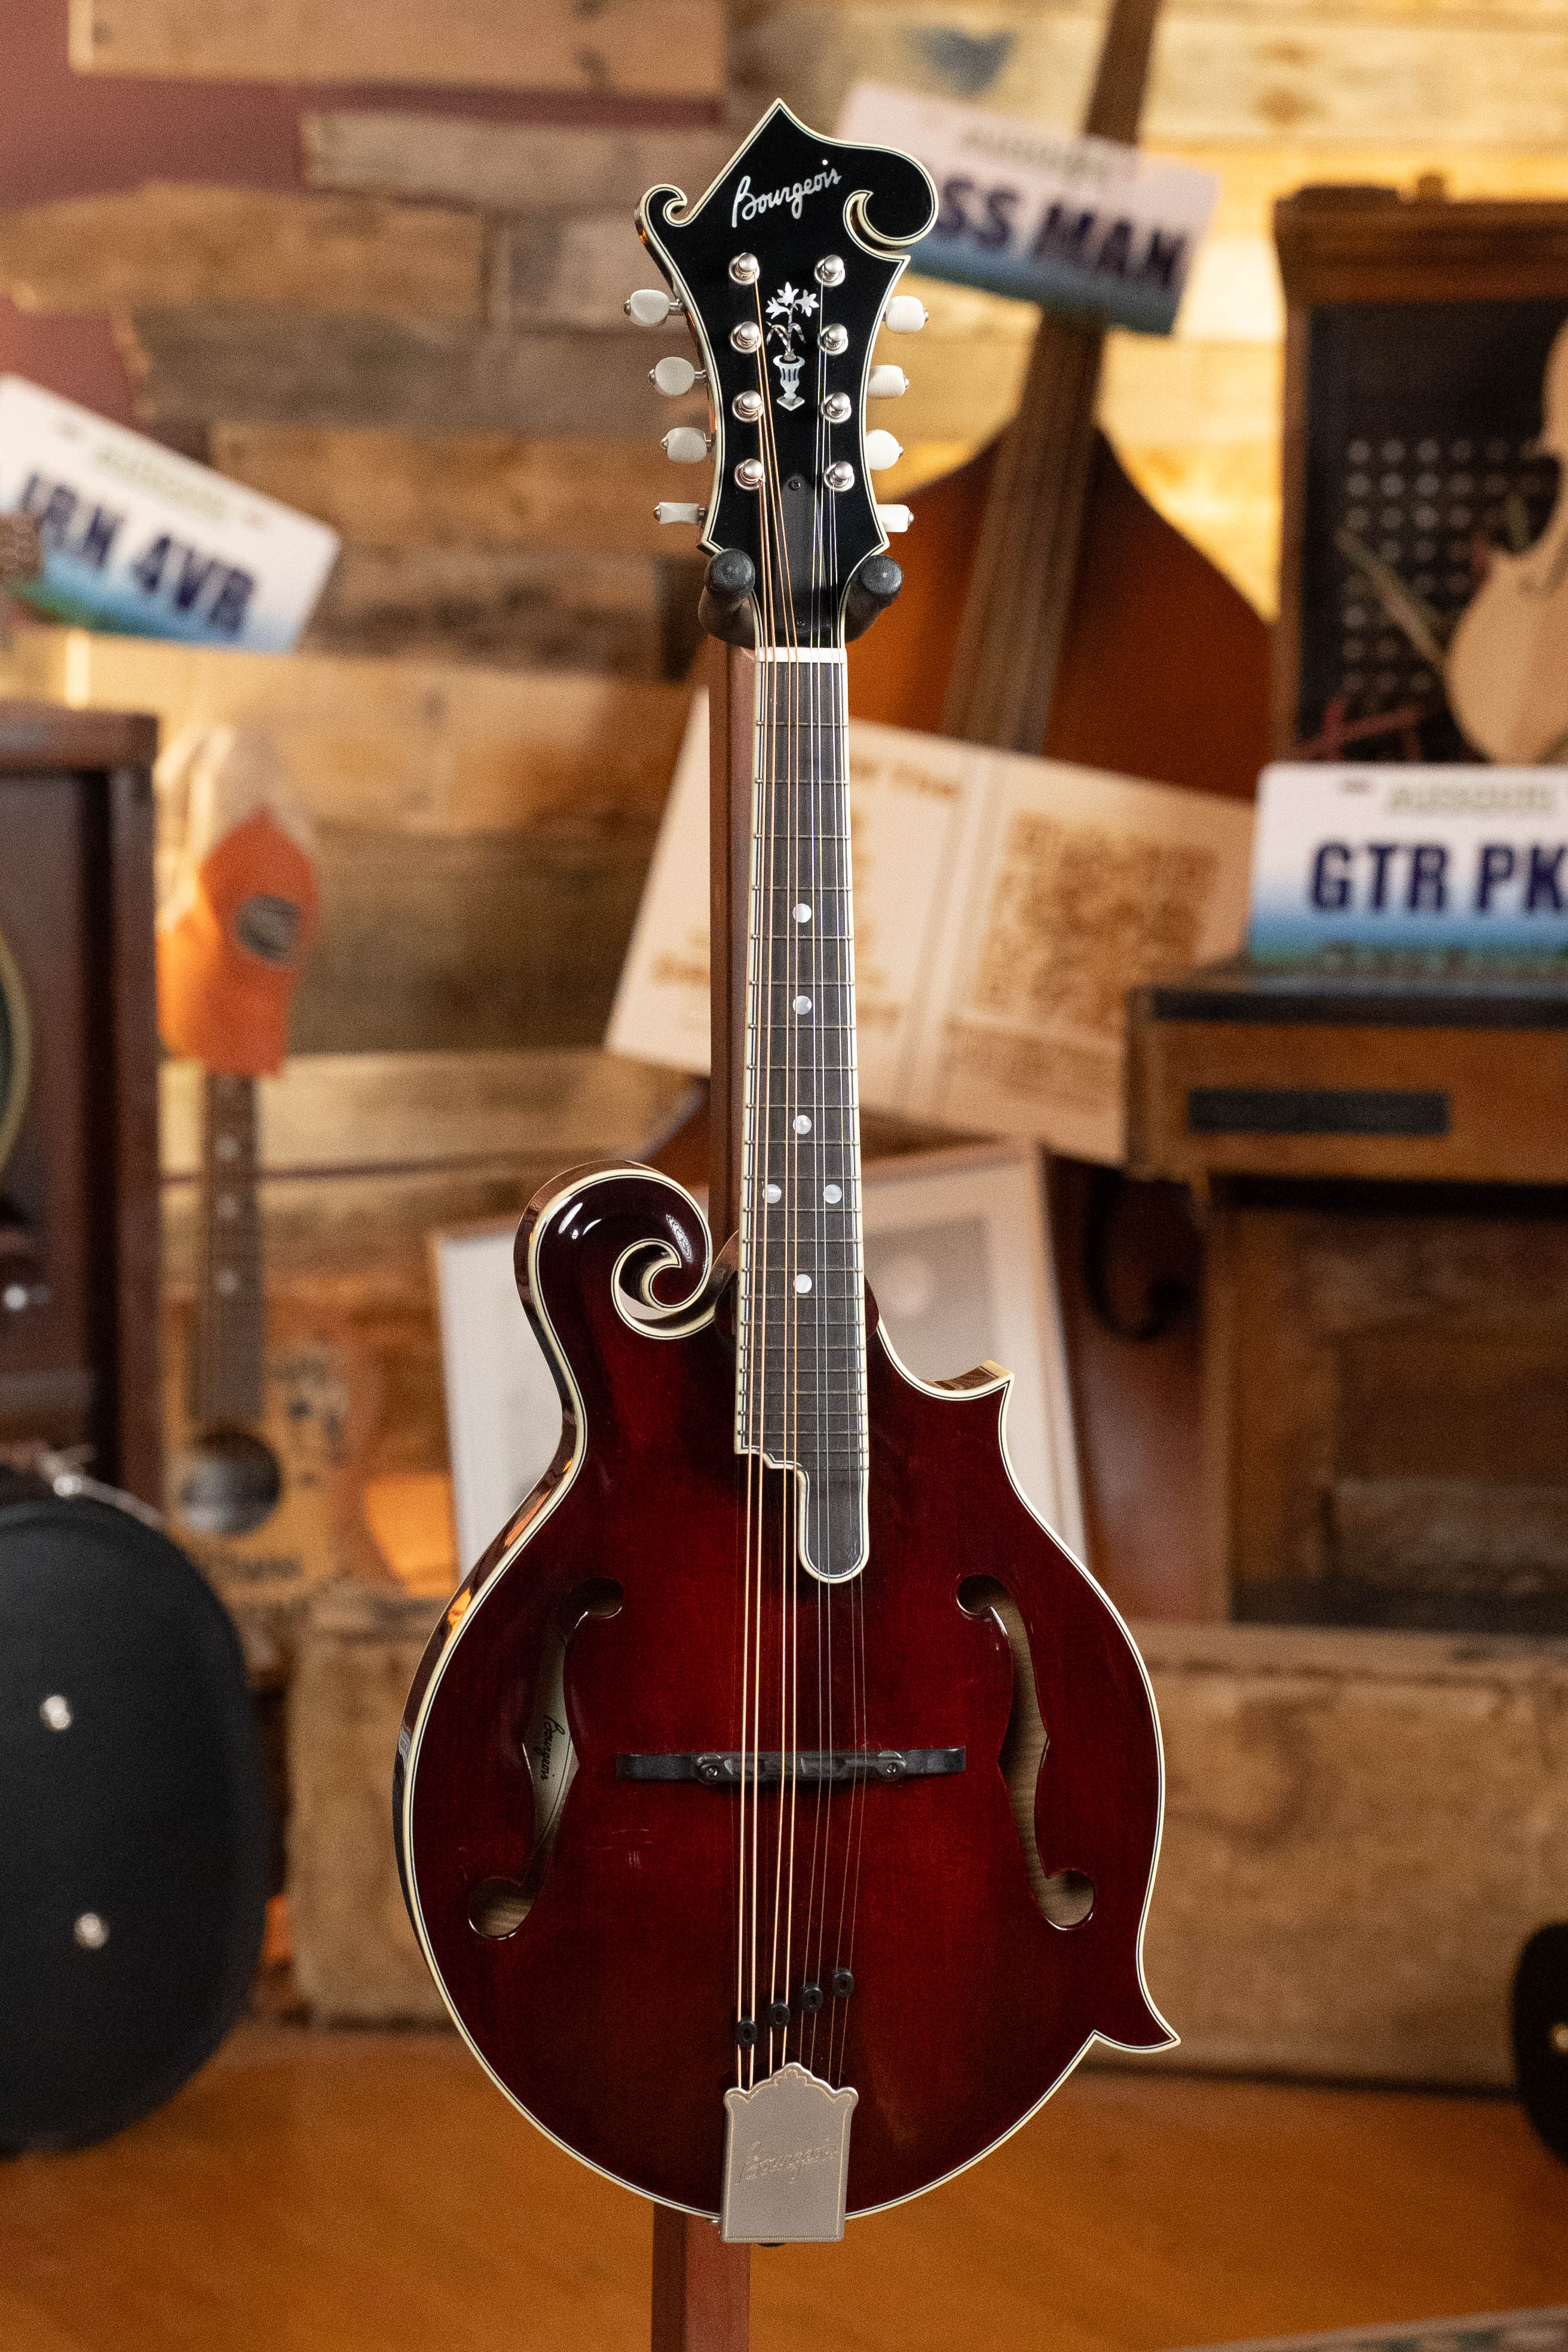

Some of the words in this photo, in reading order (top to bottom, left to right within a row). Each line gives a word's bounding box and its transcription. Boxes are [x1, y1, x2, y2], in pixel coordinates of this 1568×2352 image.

[731, 159, 842, 228] Bourgeois
[934, 175, 1018, 251] SS
[1030, 202, 1188, 289] MAN
[133, 532, 258, 642] 4VR
[1310, 840, 1449, 912] GTR
[1476, 841, 1568, 912] PK
[532, 1714, 565, 1781] Bourgeois
